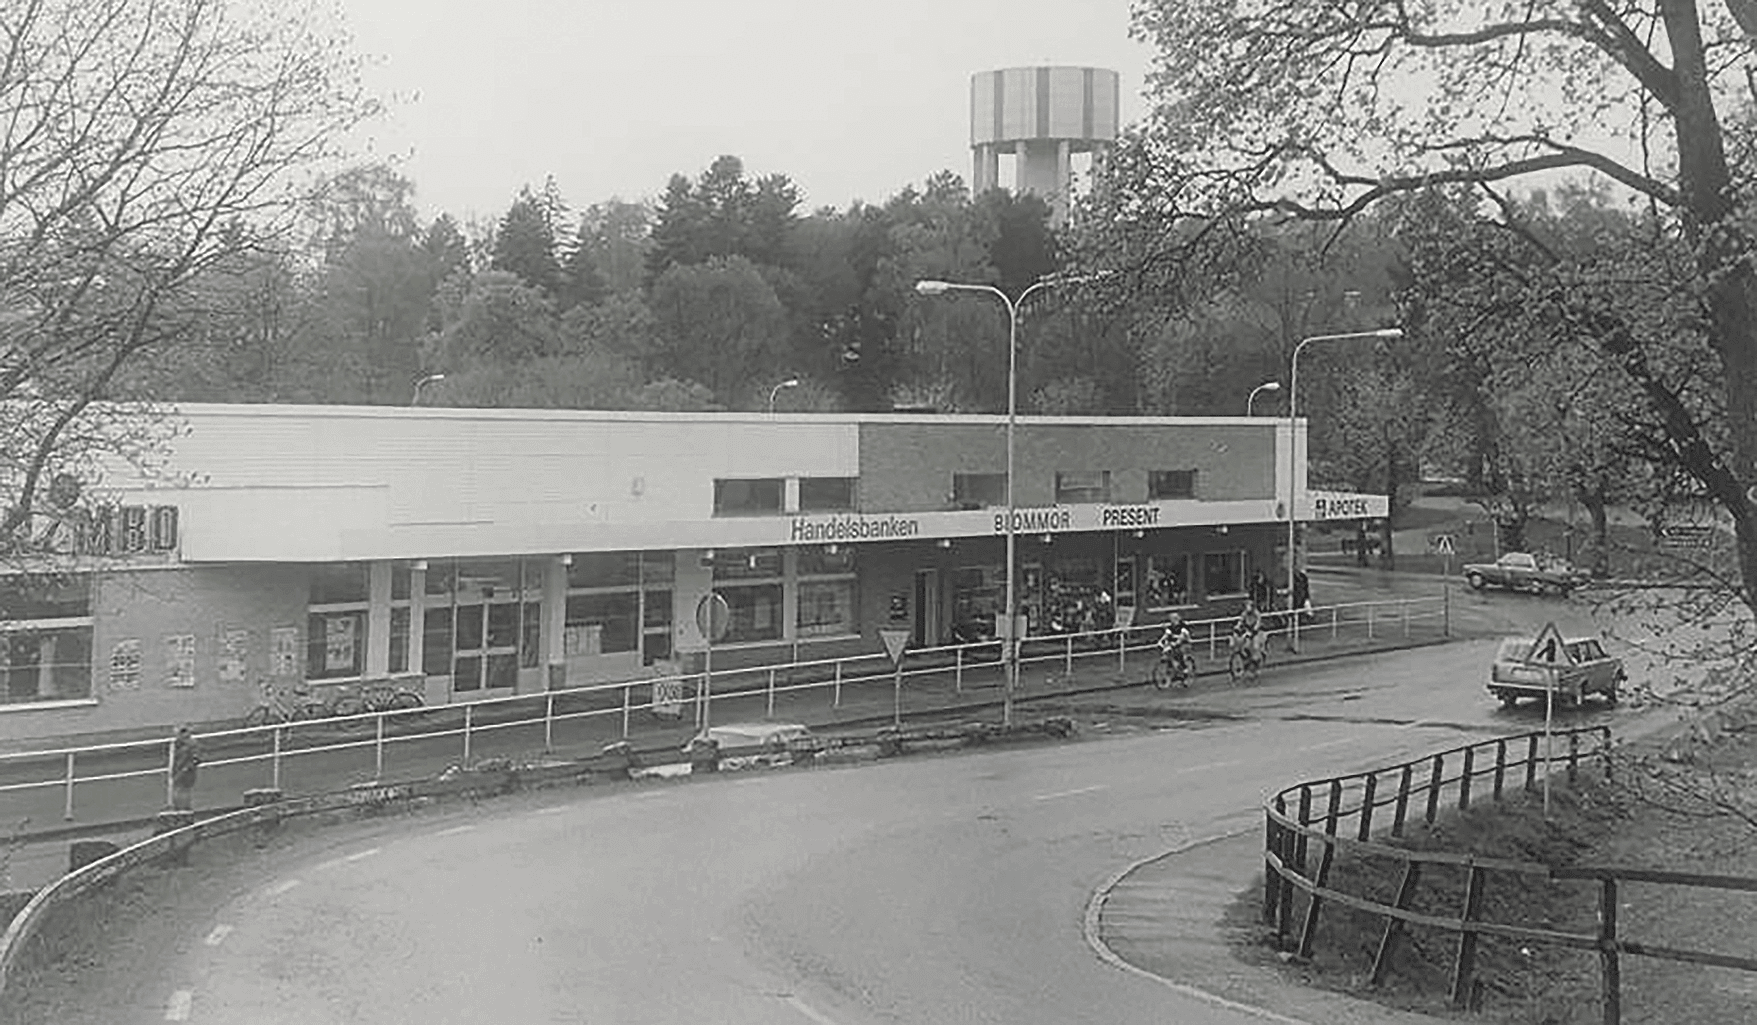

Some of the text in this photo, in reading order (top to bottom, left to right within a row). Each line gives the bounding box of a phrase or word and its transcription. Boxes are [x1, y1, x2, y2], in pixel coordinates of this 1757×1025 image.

[1103, 507, 1160, 526] PRESENT
[1328, 498, 1368, 517] APOTEK
[791, 516, 918, 541] Handelsbanken
